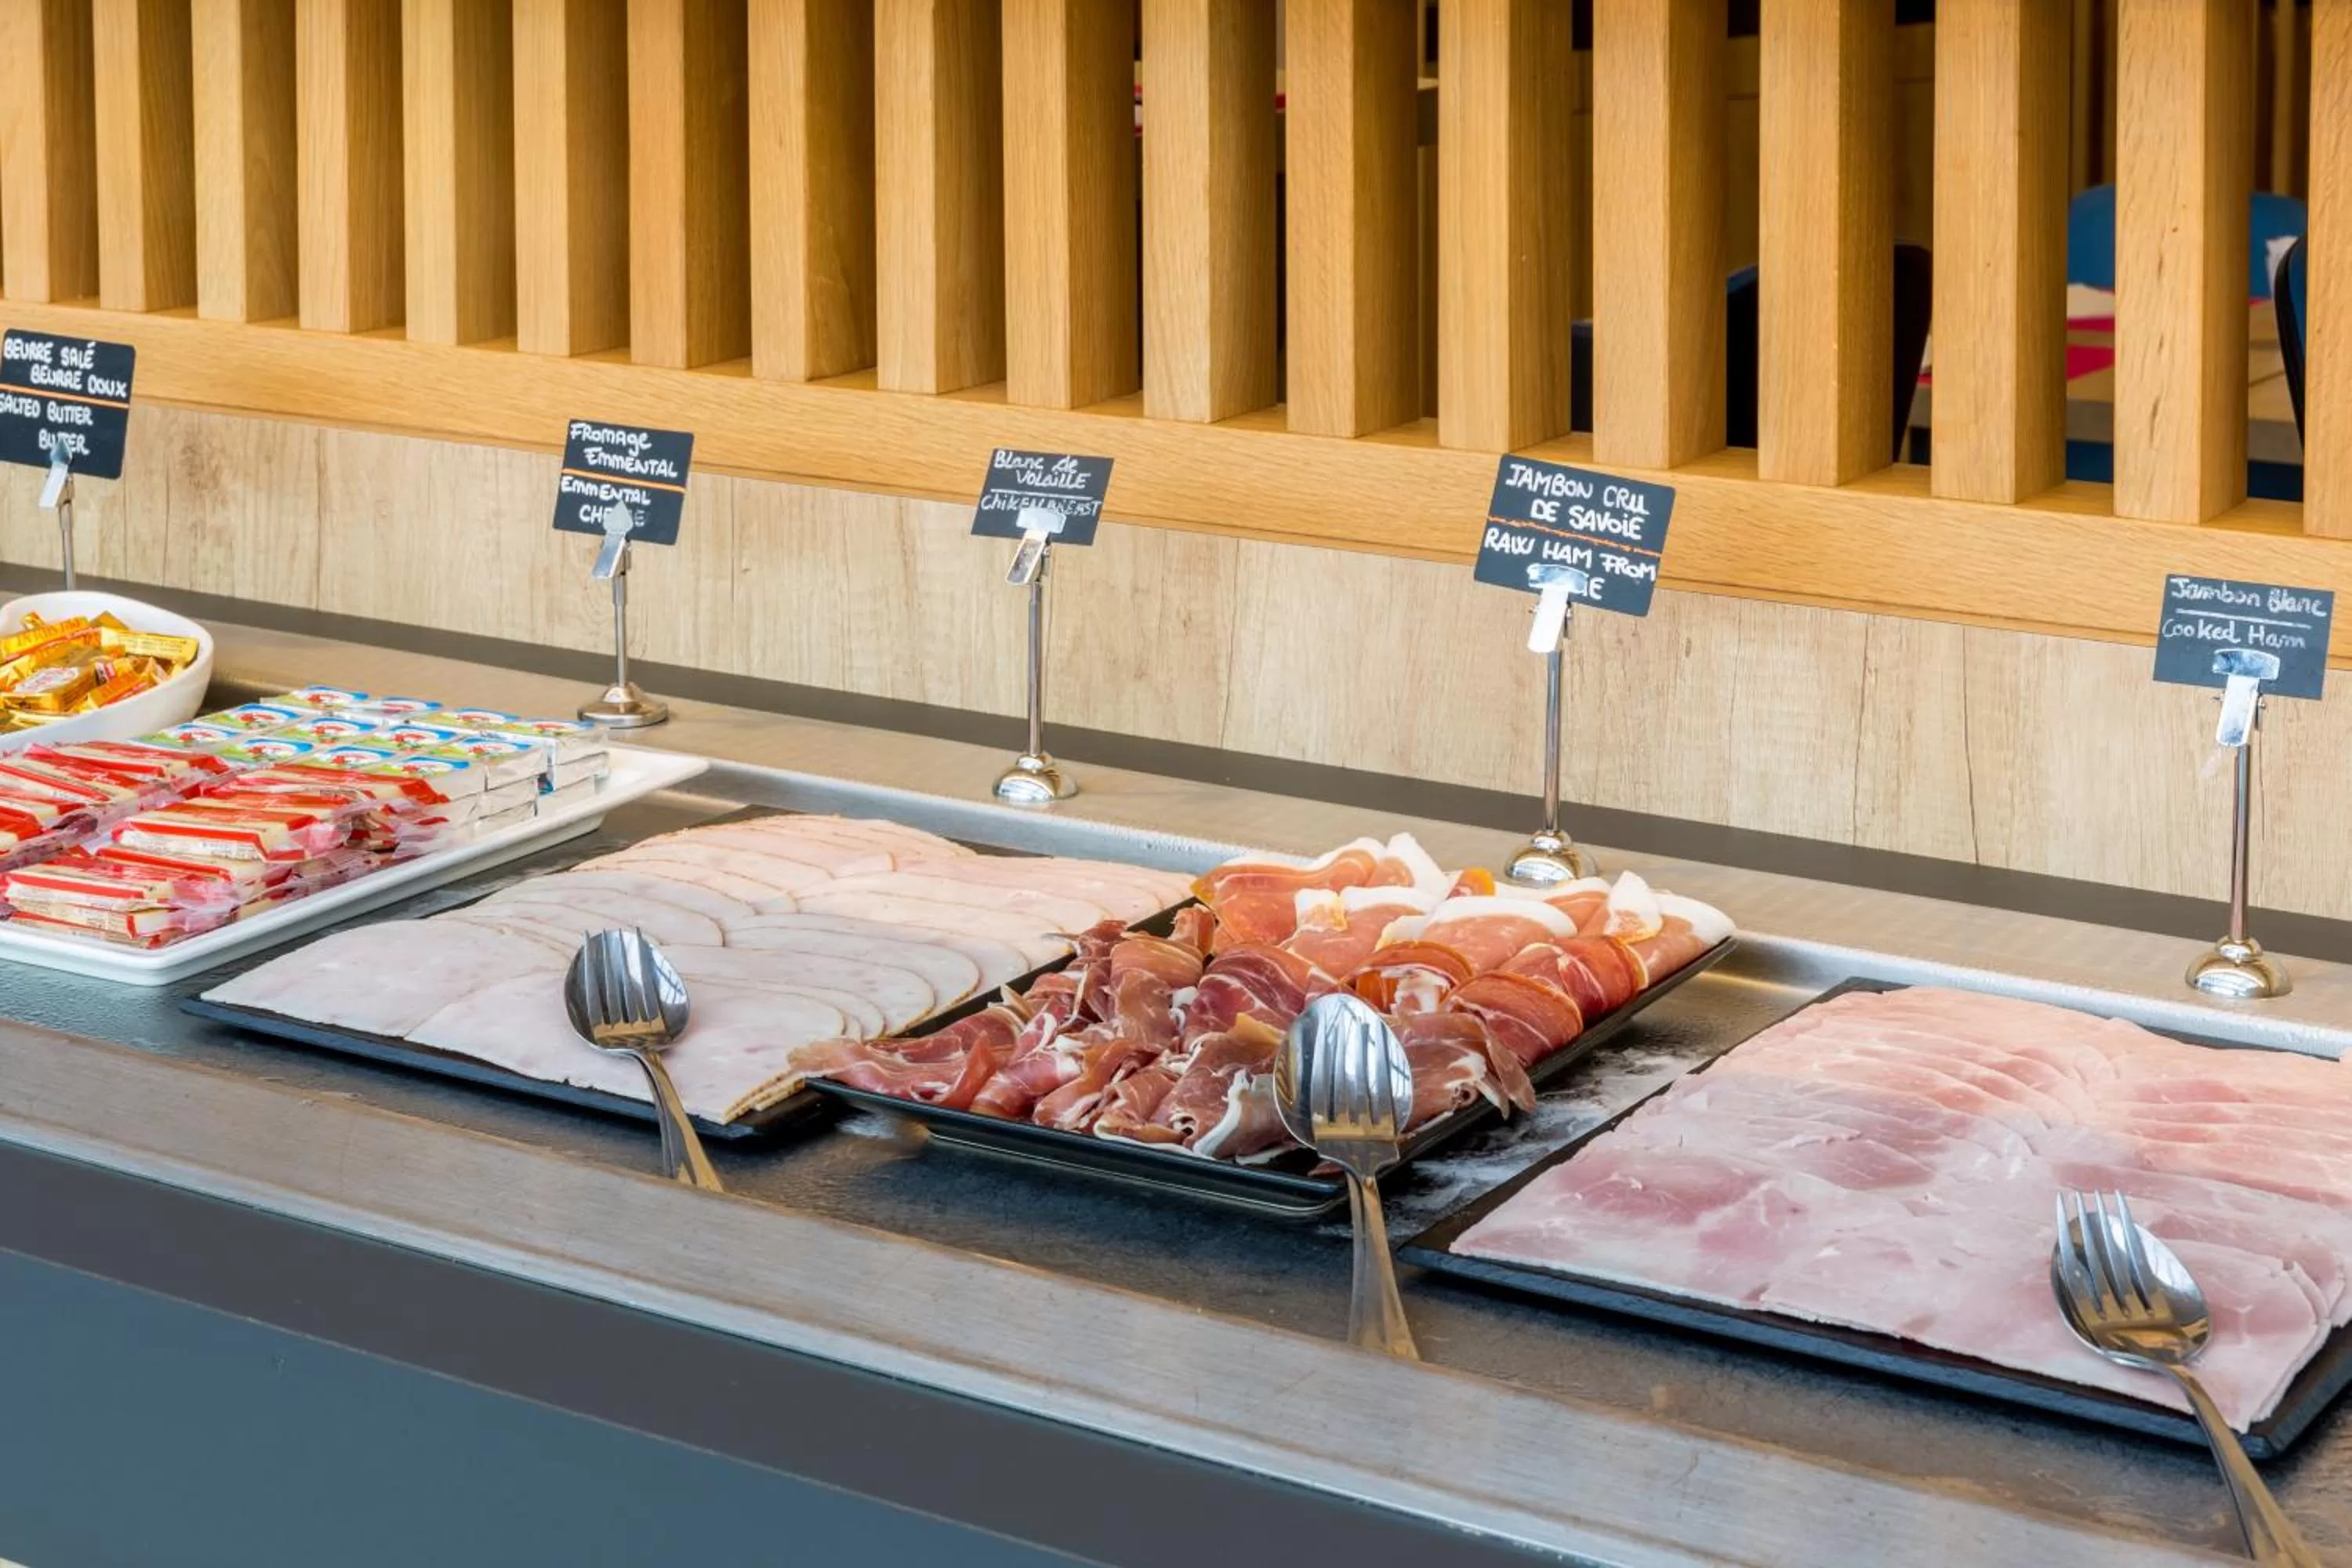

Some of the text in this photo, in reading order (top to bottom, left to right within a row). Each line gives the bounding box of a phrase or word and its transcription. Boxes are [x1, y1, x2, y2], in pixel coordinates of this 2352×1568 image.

[4, 338, 96, 369] BEURRE SALÉ
[30, 364, 128, 398] BEURRE DOUX
[47, 401, 93, 426] BUTTER
[1051, 455, 1079, 474] de
[1505, 463, 1650, 515] JAMBON CRU
[1530, 499, 1561, 523] DE
[1484, 527, 1657, 582] RAW HAM FROM
[2170, 577, 2260, 608] Jambon
[2161, 618, 2306, 649] Cooked Ham
